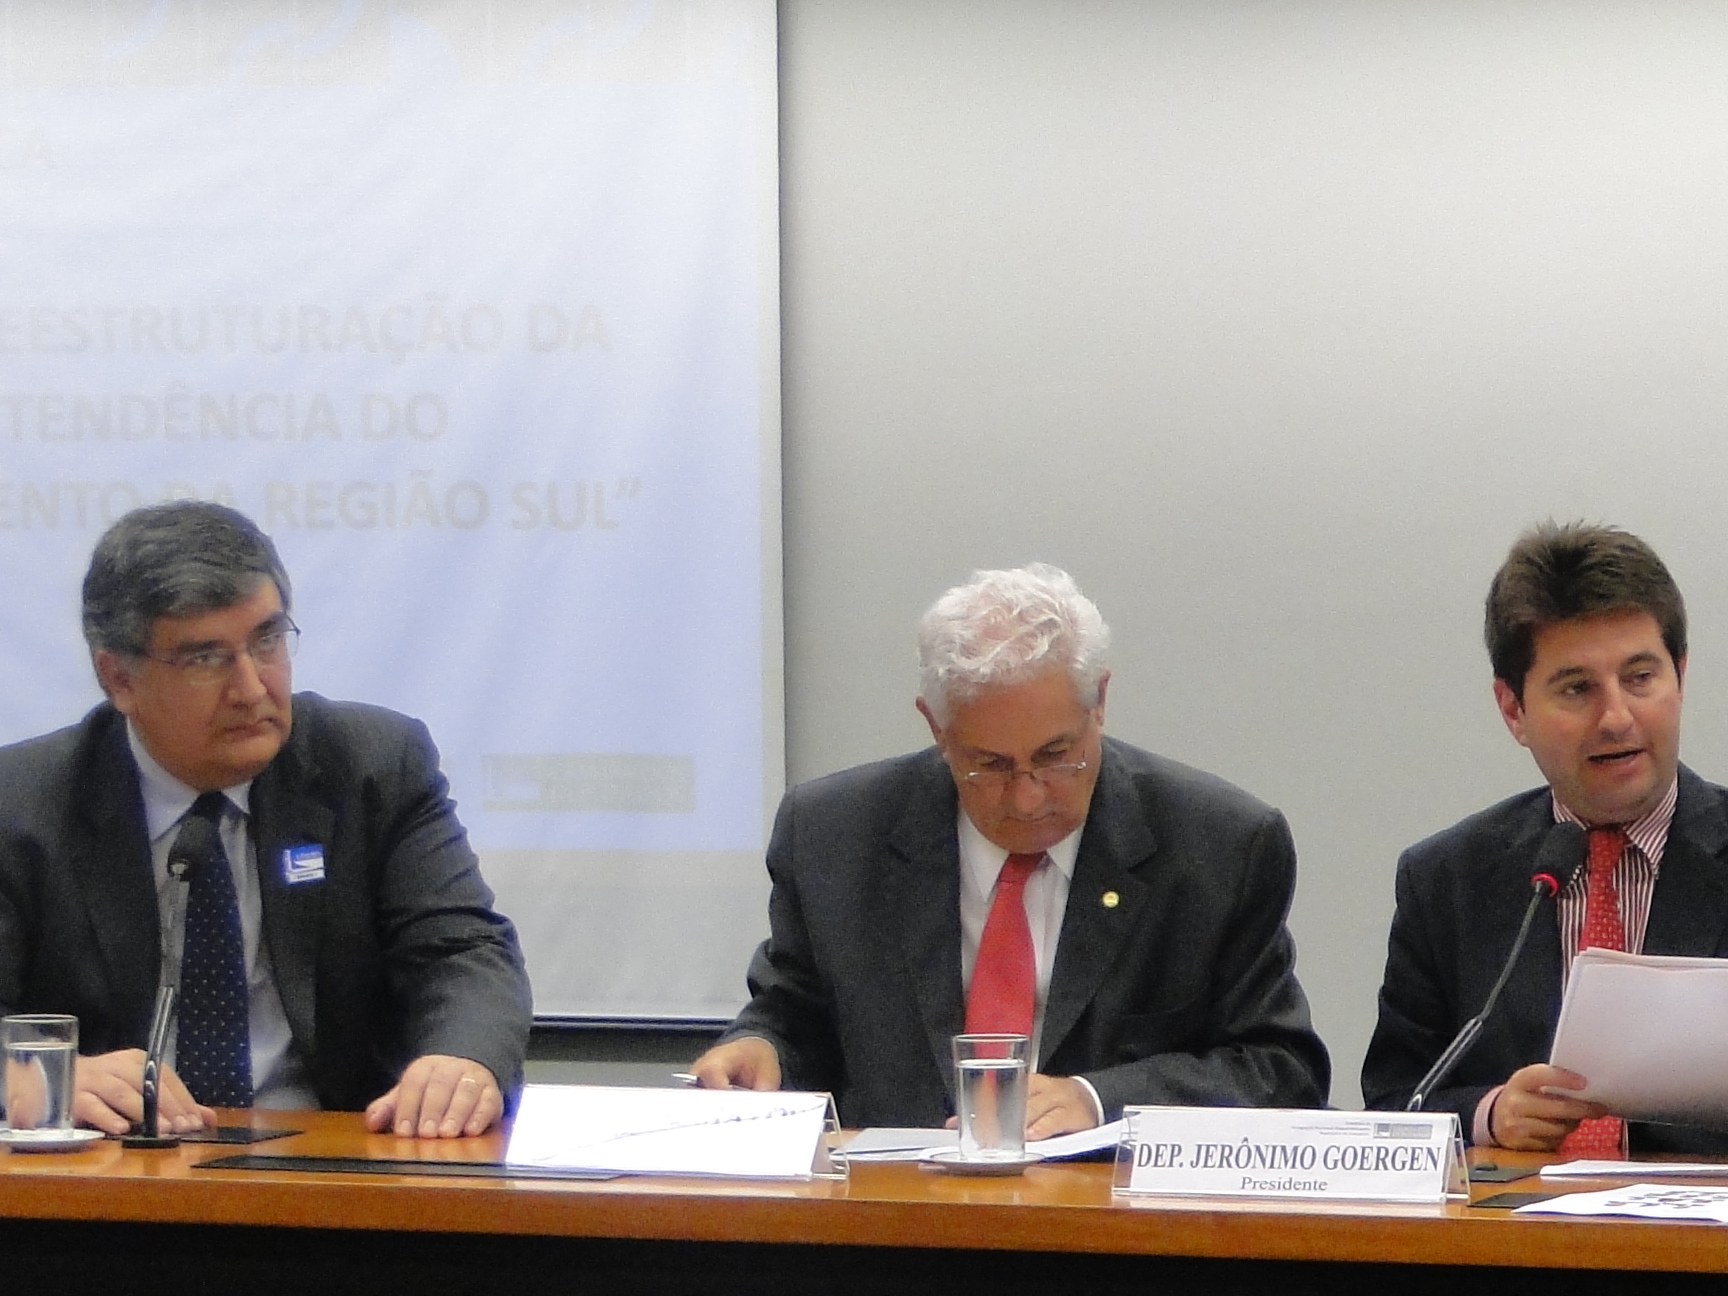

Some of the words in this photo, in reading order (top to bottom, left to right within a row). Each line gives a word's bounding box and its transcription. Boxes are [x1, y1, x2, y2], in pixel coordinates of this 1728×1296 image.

[527, 302, 612, 355] DA
[360, 391, 450, 442] DO
[265, 469, 490, 531] REGIÃO
[1137, 1142, 1184, 1169] DEP.
[1190, 1137, 1316, 1171] JERÔNIMO
[1323, 1144, 1441, 1172] GOERGEN
[1241, 1176, 1328, 1192] Presidente
